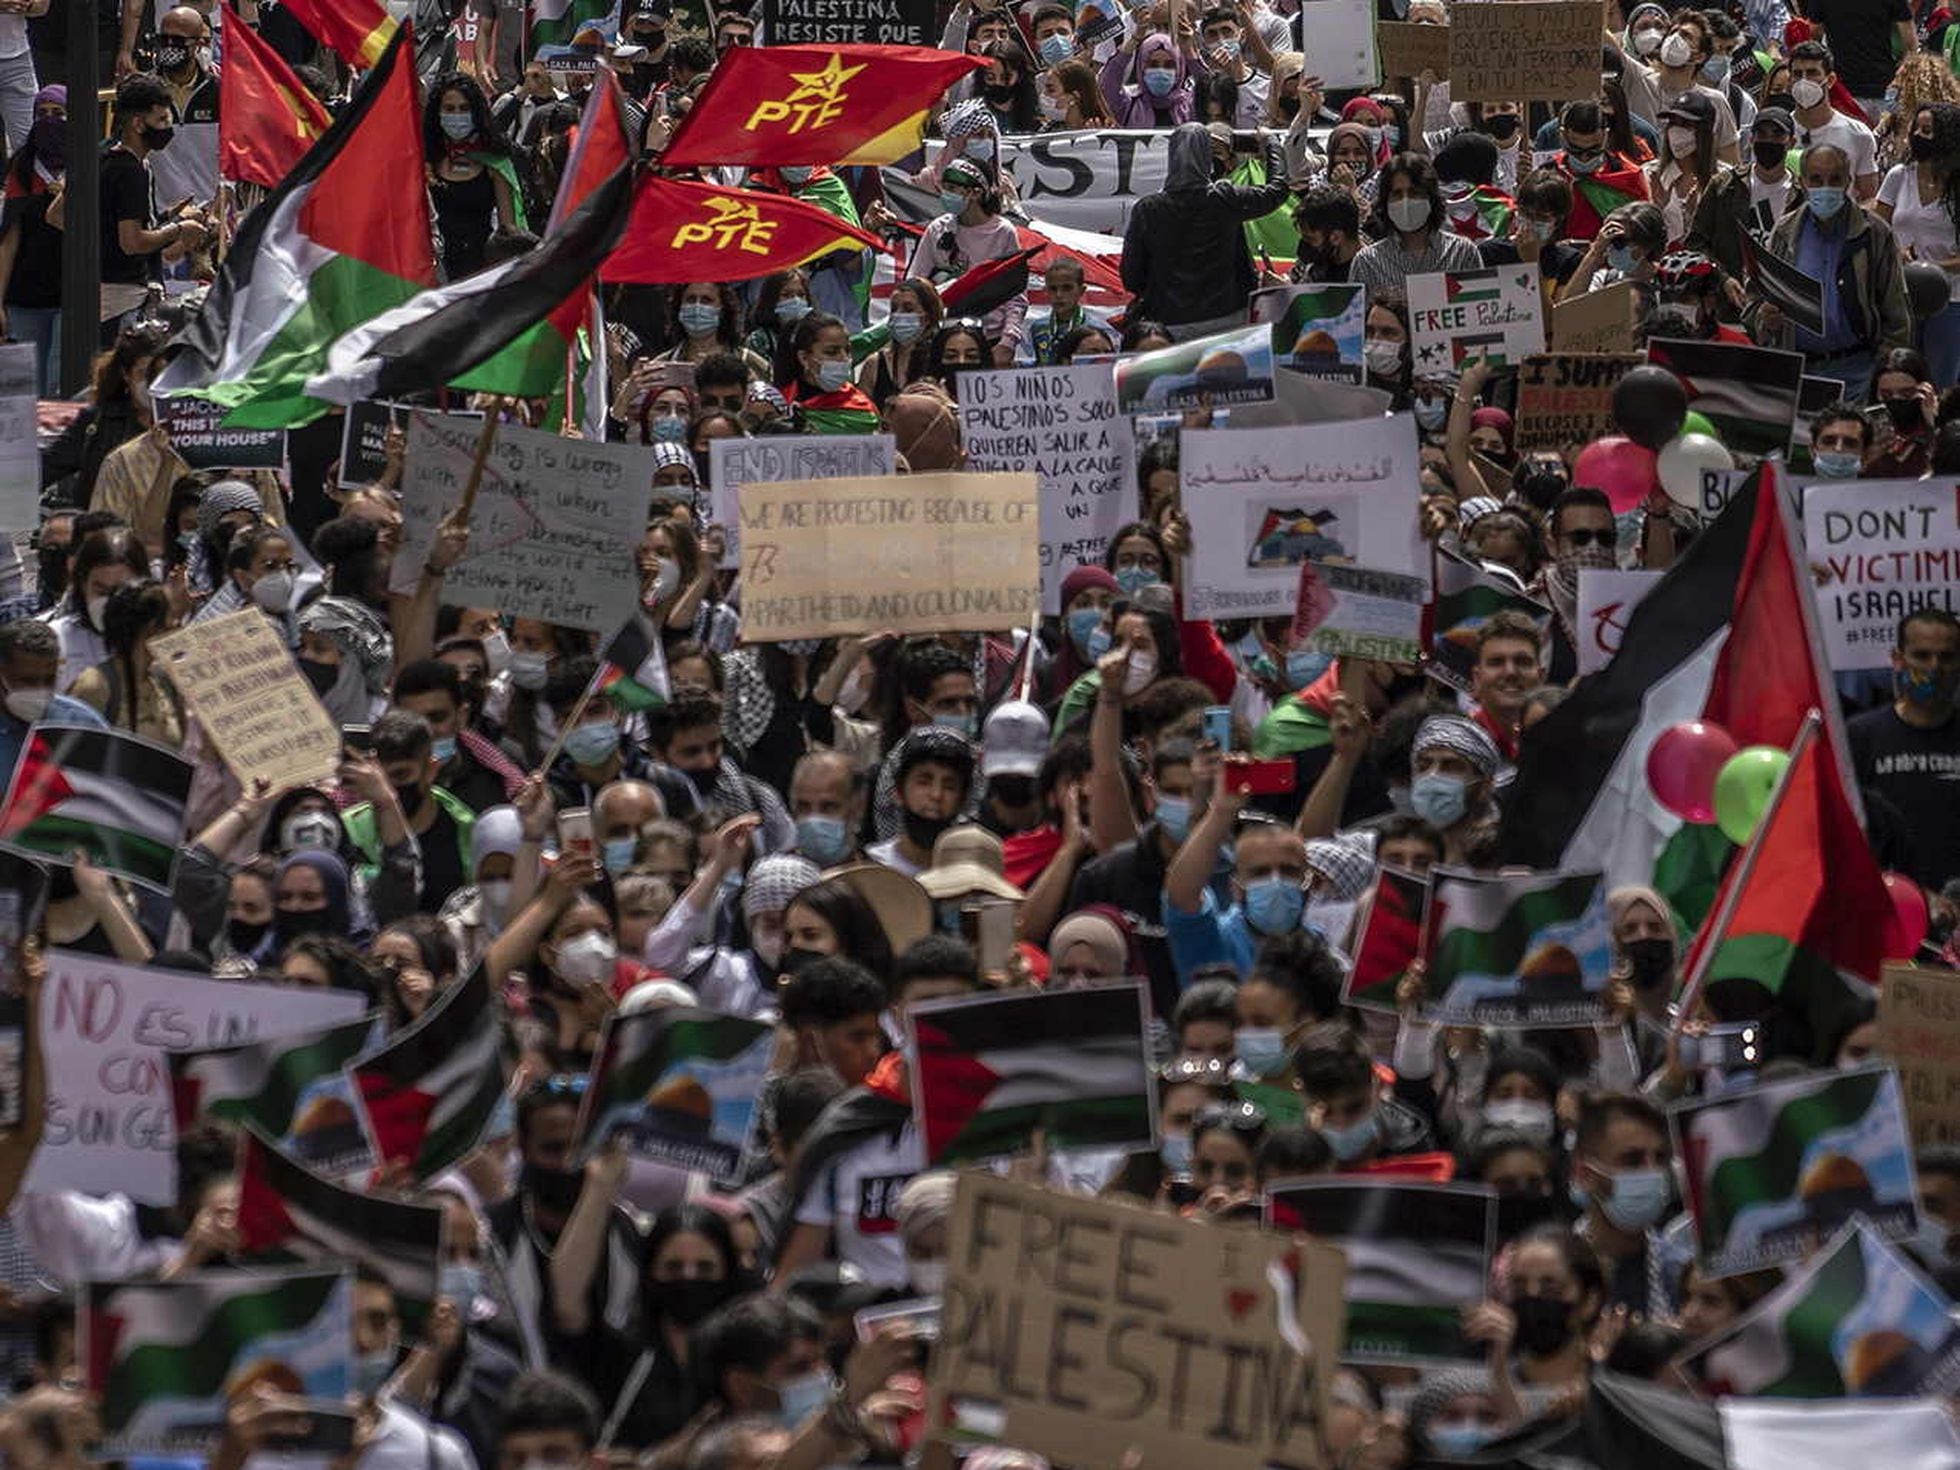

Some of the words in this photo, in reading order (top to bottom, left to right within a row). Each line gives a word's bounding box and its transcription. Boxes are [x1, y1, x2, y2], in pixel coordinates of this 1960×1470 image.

[778, 0, 900, 19] PALESTINA
[775, 22, 866, 43] RESISTE
[878, 24, 922, 46] QUE
[744, 94, 848, 135] PTE
[670, 221, 779, 256] PTE
[1413, 305, 1467, 333] FREE
[1015, 372, 1075, 401] NIÑOS
[171, 420, 207, 431] THIS
[965, 403, 1069, 431] PALESTINOS
[171, 435, 213, 447] YOUR
[968, 434, 1037, 457] QUIEREN
[1045, 431, 1090, 451] SALIR
[1097, 430, 1110, 451] A
[1071, 481, 1085, 497] A
[736, 501, 774, 531] WE
[777, 498, 813, 528] ARE
[814, 497, 915, 527] PROTESTING
[1002, 499, 1038, 524] OF
[1824, 504, 1938, 544] DON'T
[54, 973, 126, 1045] NO
[132, 999, 198, 1050] ES
[970, 1192, 1184, 1314] FREE
[1221, 1241, 1242, 1278] I
[932, 1278, 1332, 1464] PALESTINA
